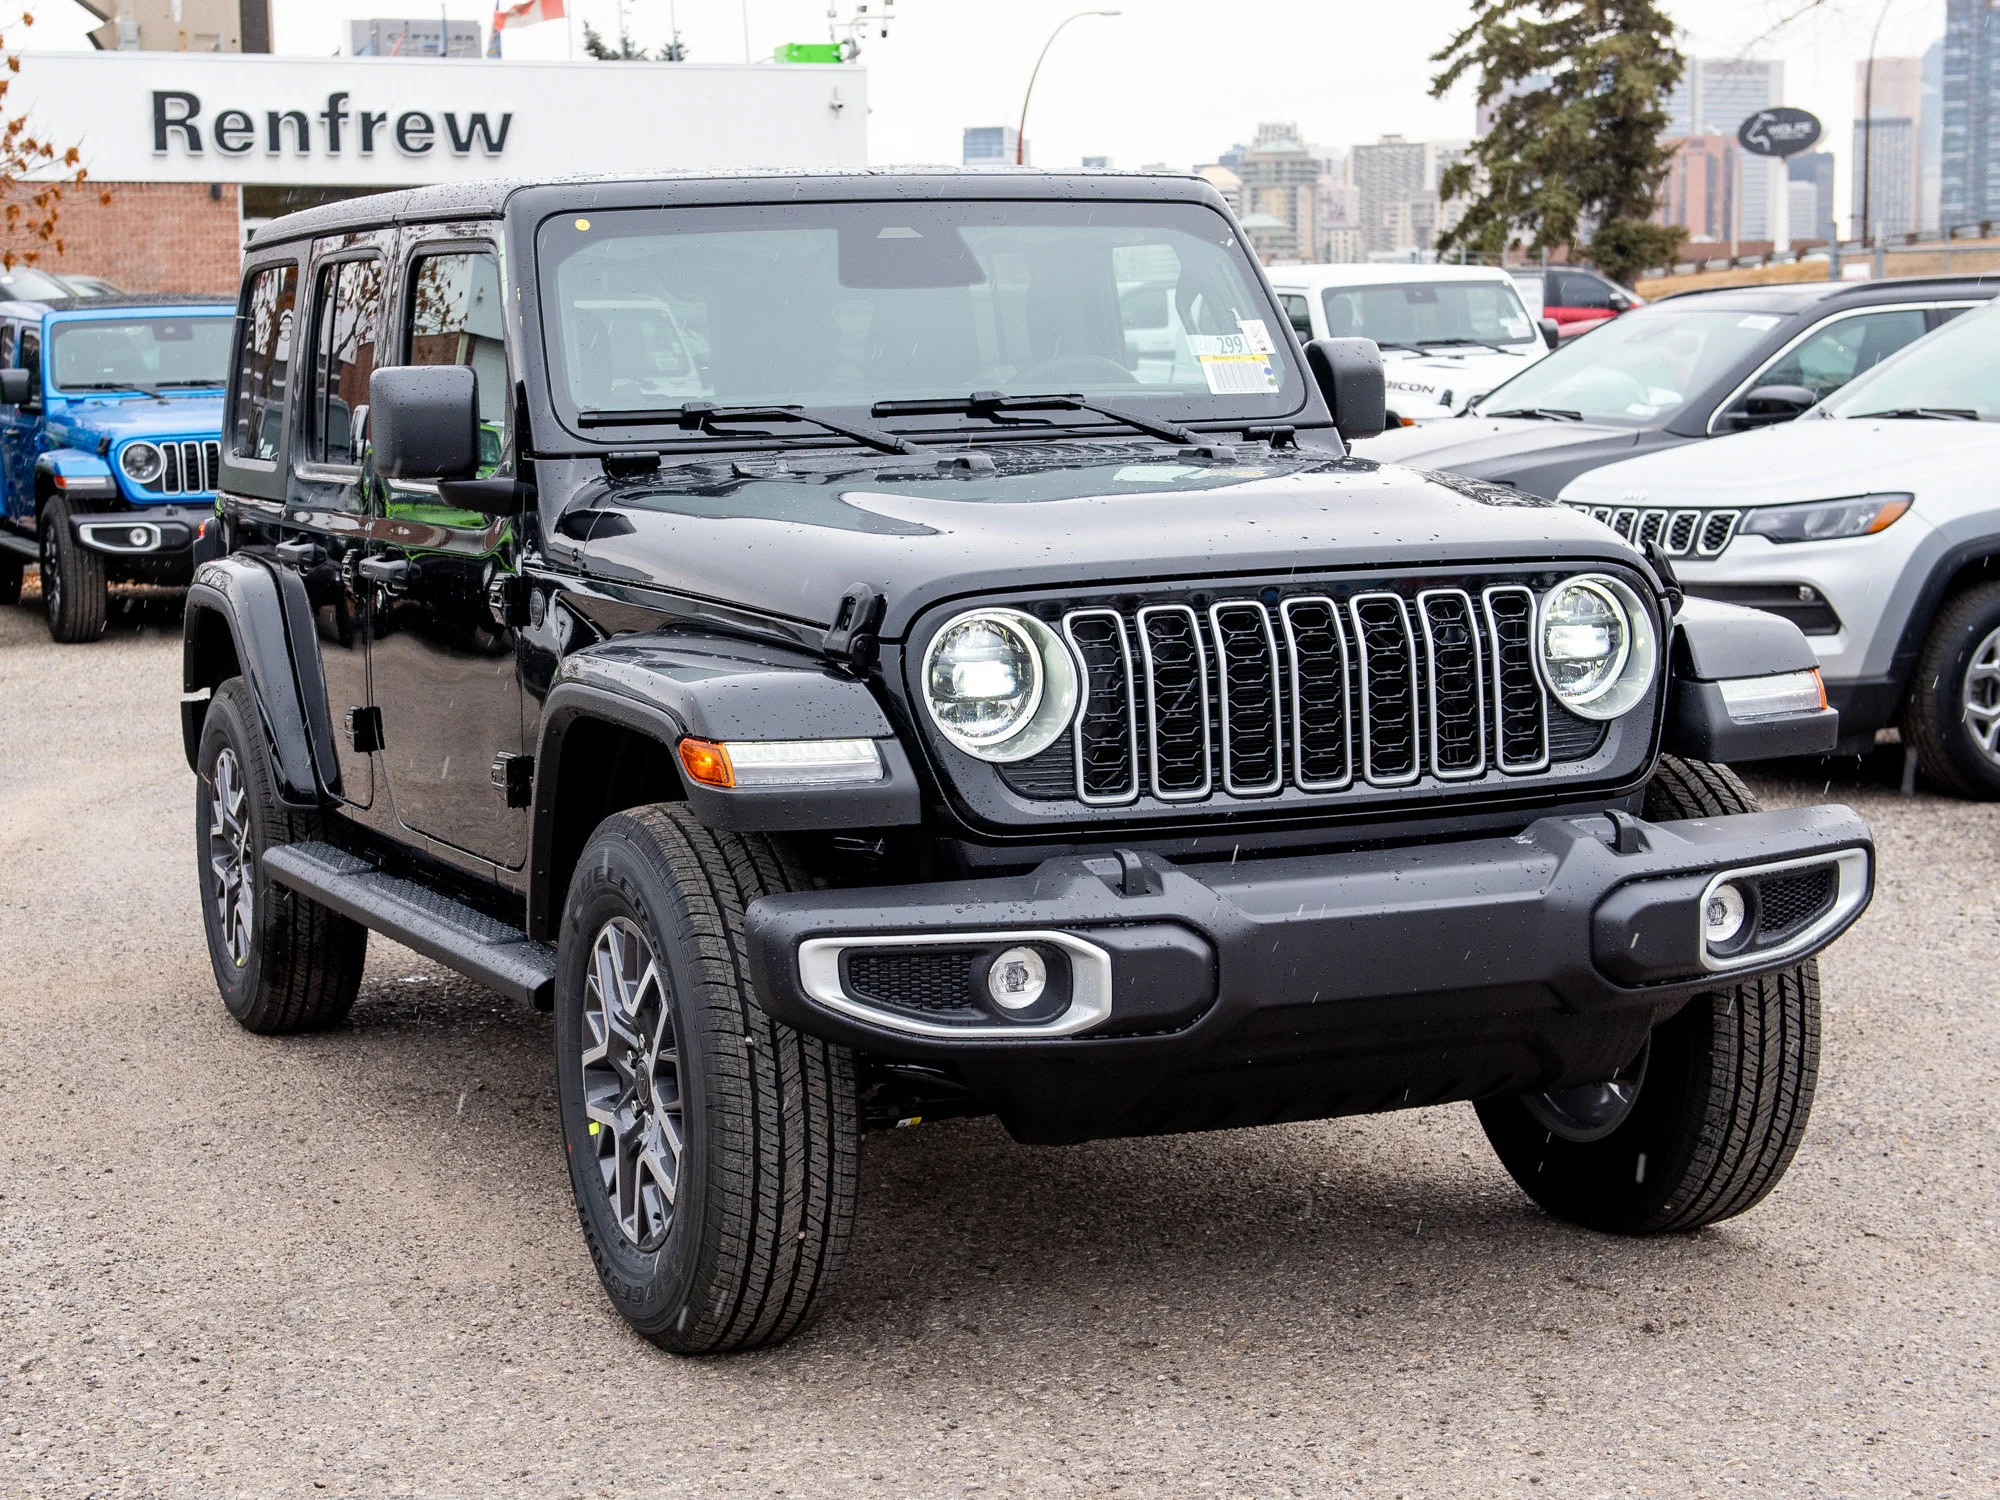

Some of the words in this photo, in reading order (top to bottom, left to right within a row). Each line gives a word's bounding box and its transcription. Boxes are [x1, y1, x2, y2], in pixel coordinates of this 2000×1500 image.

[152, 90, 513, 154] Renfrew
[1216, 335, 1243, 354] 299
[1385, 381, 1435, 394] BICON
